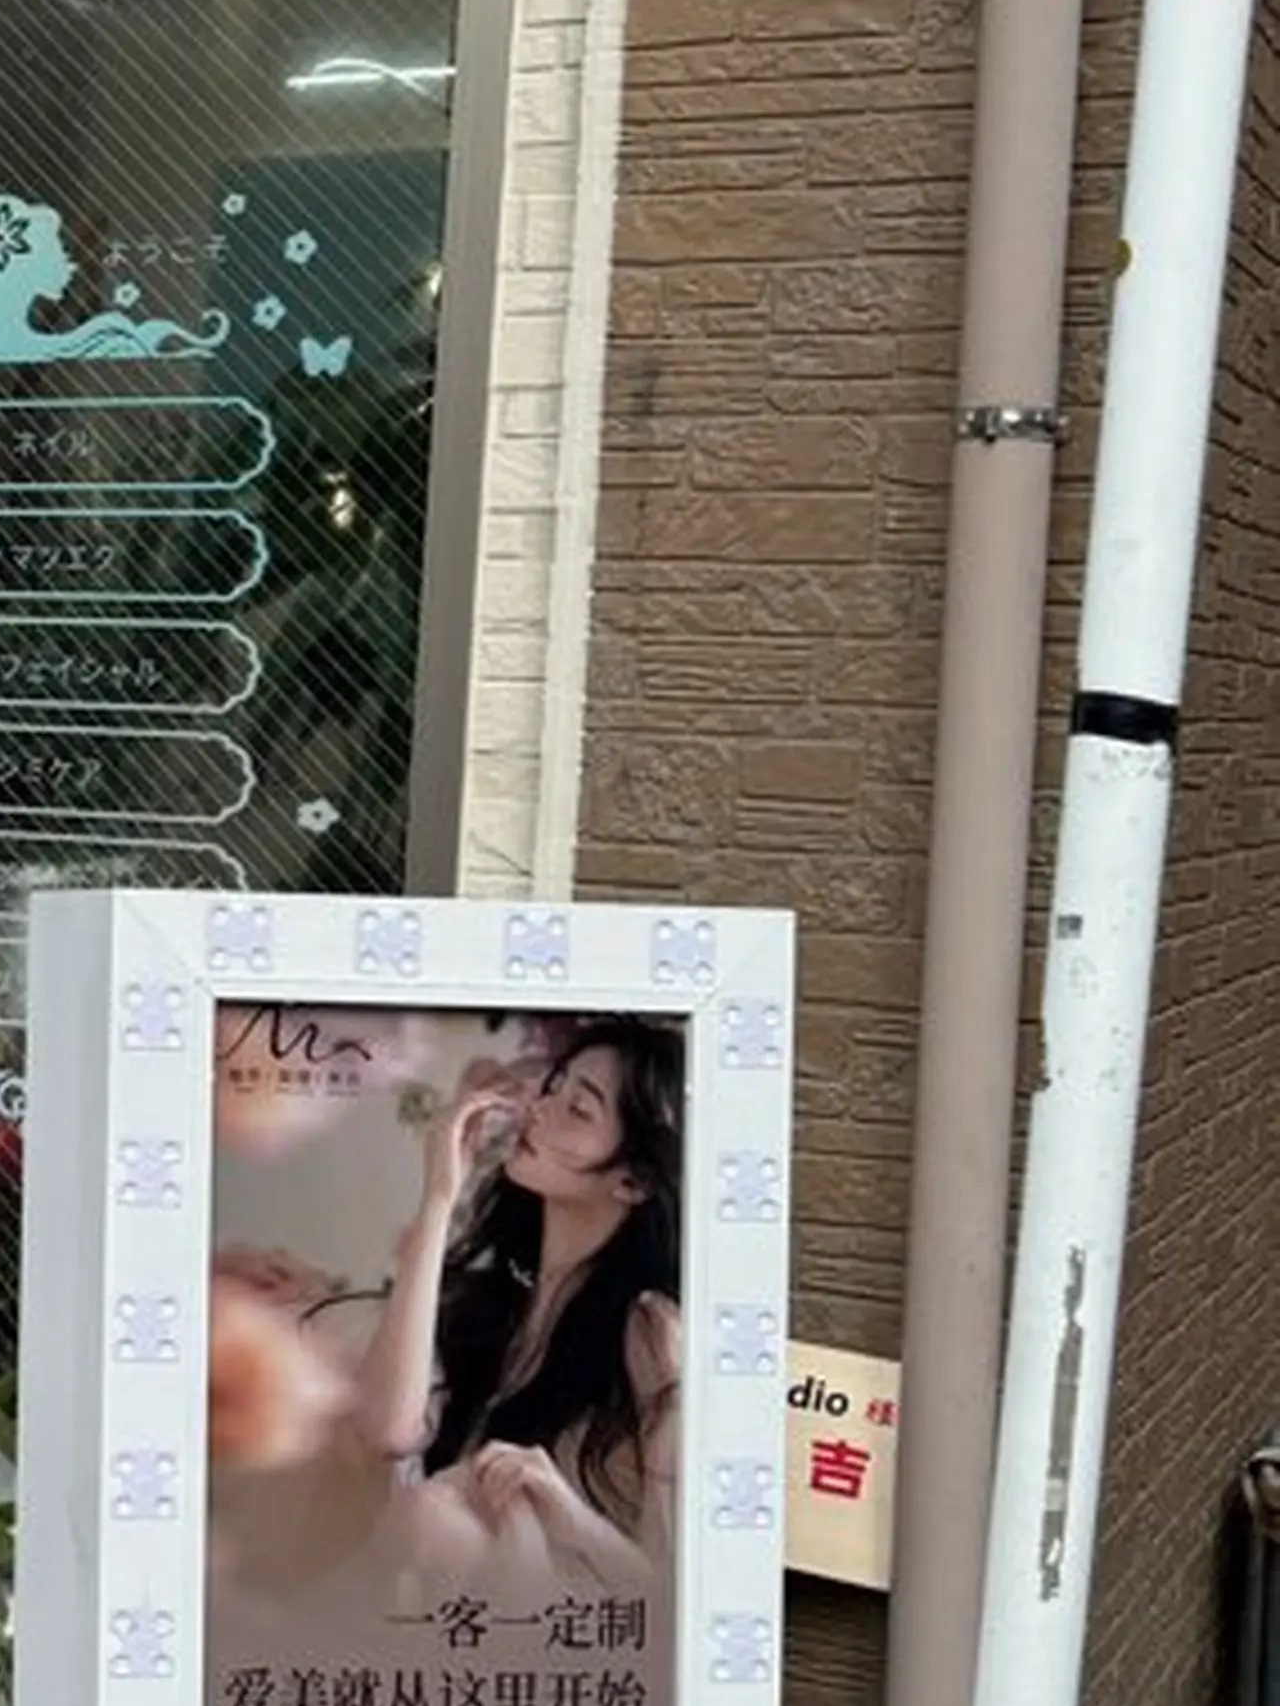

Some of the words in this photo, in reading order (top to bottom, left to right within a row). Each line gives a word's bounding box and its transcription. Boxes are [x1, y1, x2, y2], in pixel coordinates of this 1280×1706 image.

[102, 234, 230, 268] ようこそ
[13, 428, 92, 459] ネイル
[9, 545, 114, 573] マツエク
[809, 1437, 871, 1501] 吉
[386, 1596, 648, 1652] 一客一定制
